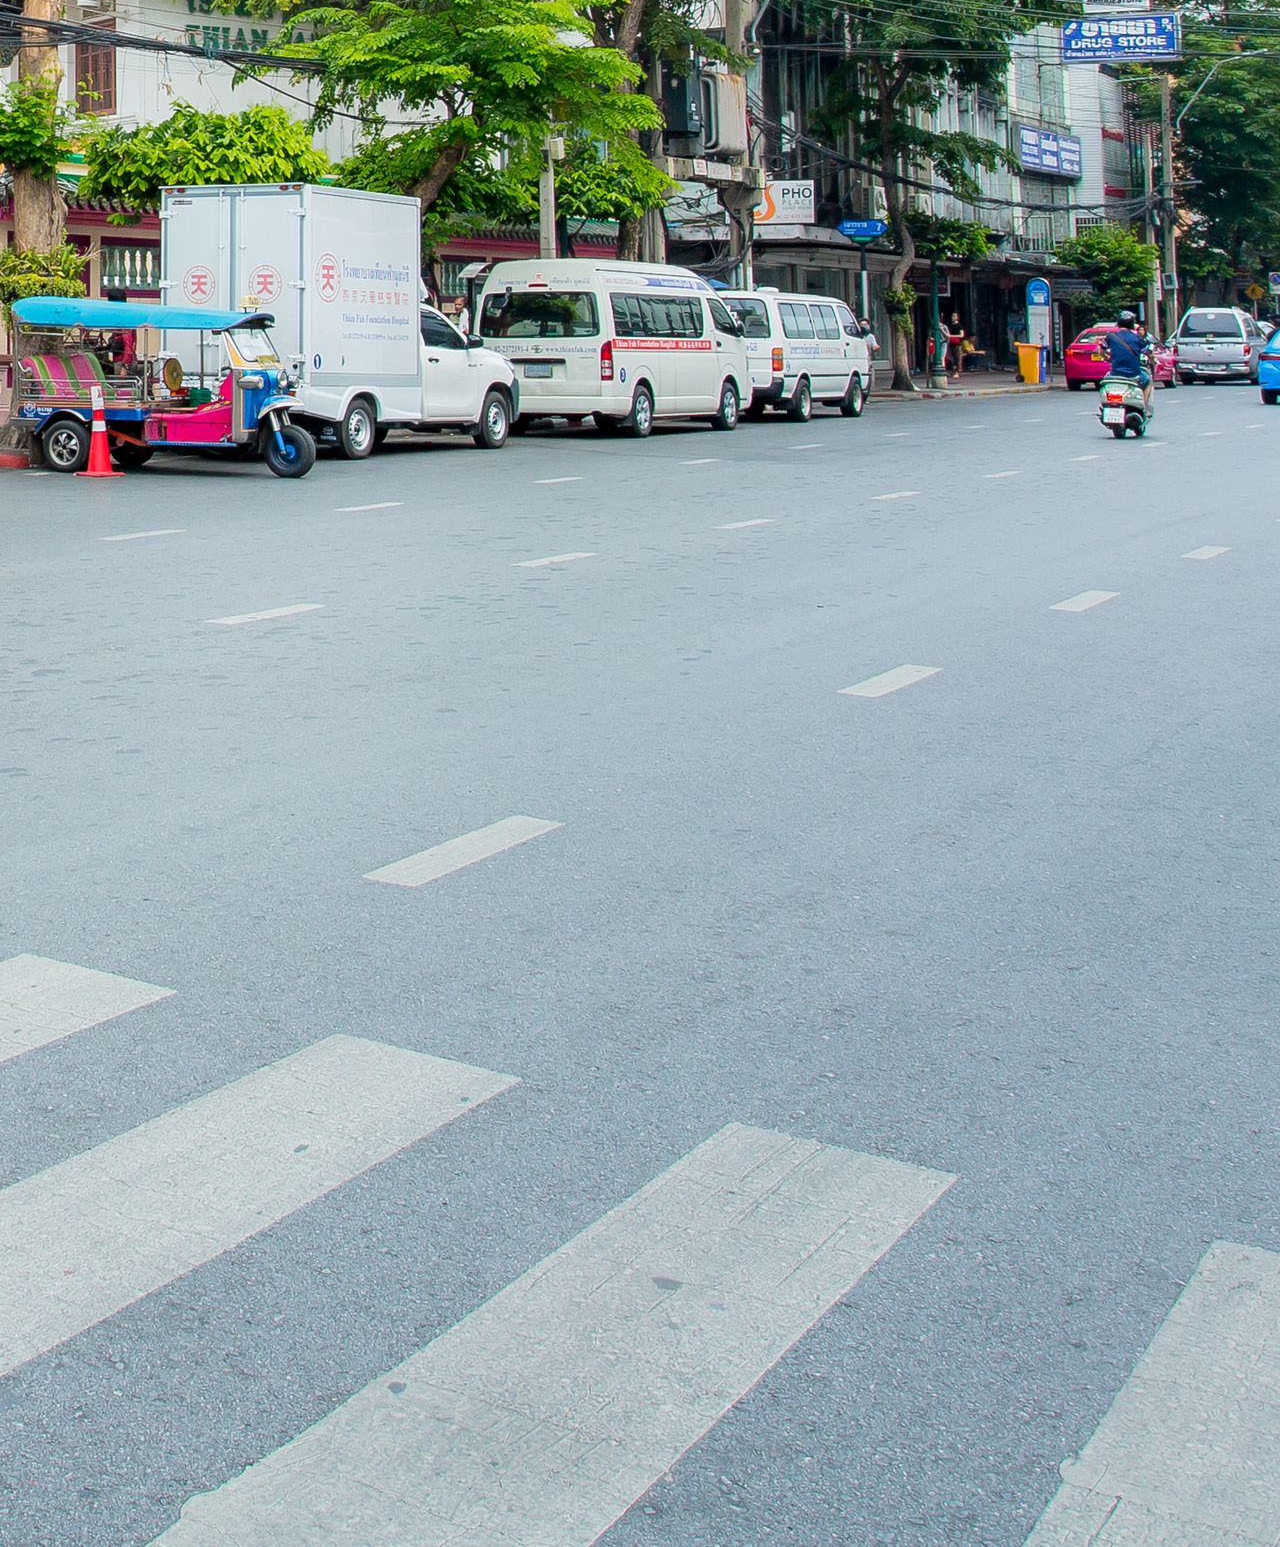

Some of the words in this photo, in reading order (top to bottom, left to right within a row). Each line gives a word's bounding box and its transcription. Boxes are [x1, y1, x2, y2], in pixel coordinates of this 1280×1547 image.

[1071, 37, 1113, 49] DRUG
[1118, 35, 1167, 48] STORE
[782, 187, 812, 199] PHO
[875, 223, 882, 231] 7
[191, 274, 208, 296] 天
[257, 274, 273, 296] 天
[322, 265, 335, 291] 天
